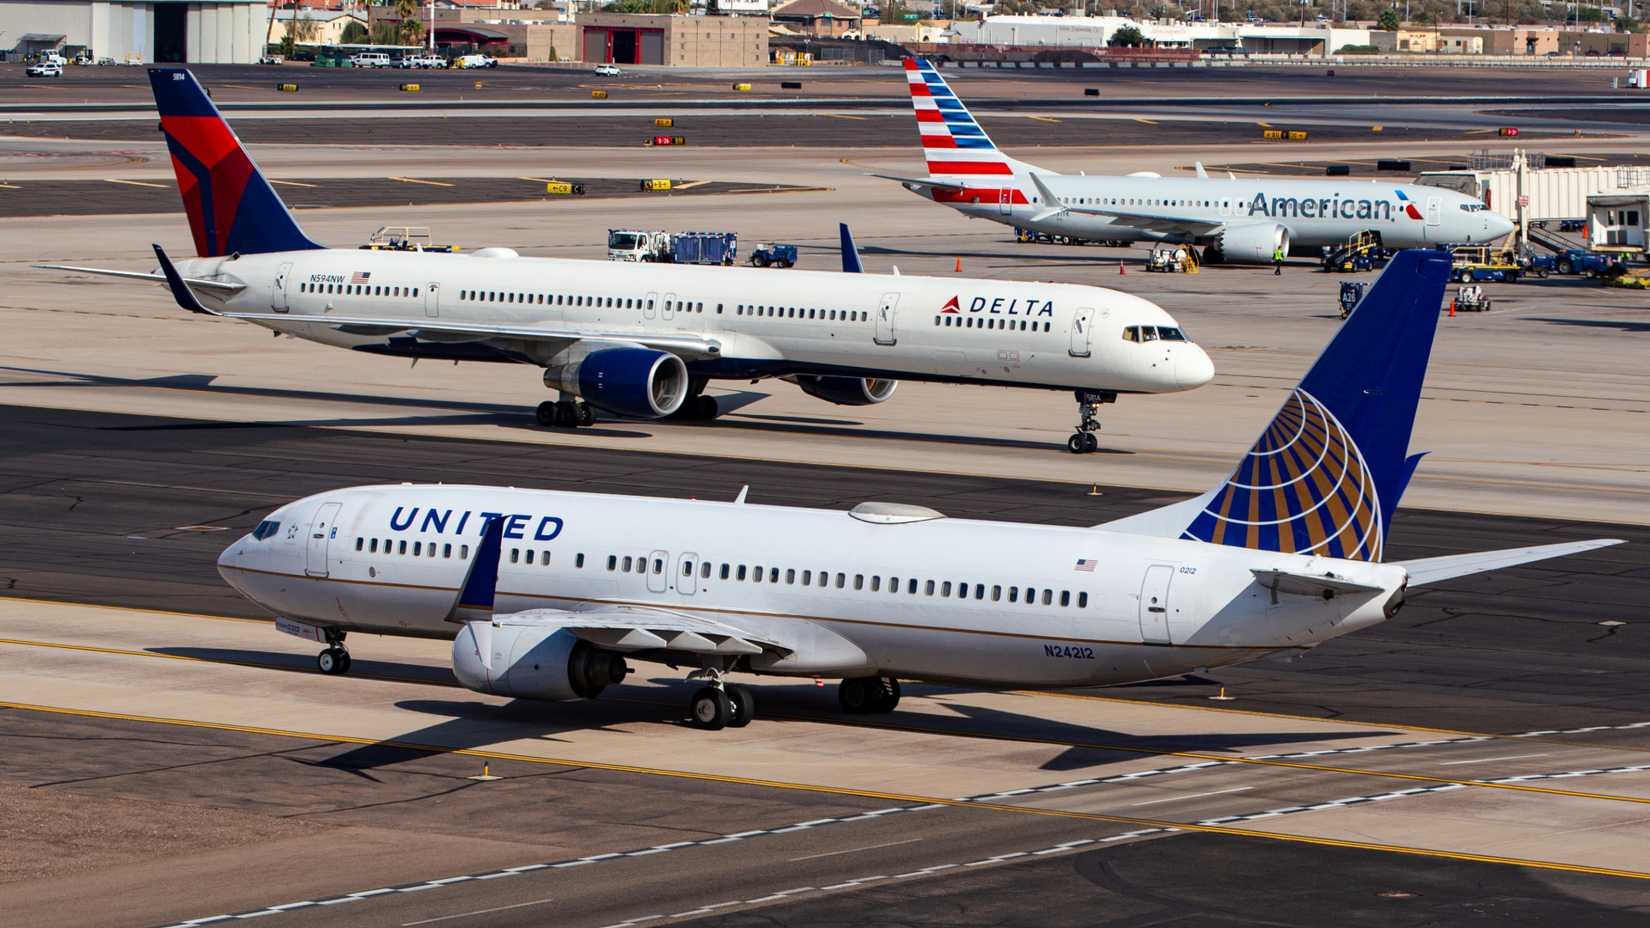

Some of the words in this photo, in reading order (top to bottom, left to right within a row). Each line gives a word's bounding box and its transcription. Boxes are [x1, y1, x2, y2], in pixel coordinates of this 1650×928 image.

[1248, 192, 1391, 220] American
[310, 274, 345, 283] N594NW
[970, 297, 1053, 316] DELTA
[390, 506, 564, 541] UNITED
[1044, 645, 1096, 659] N24212
